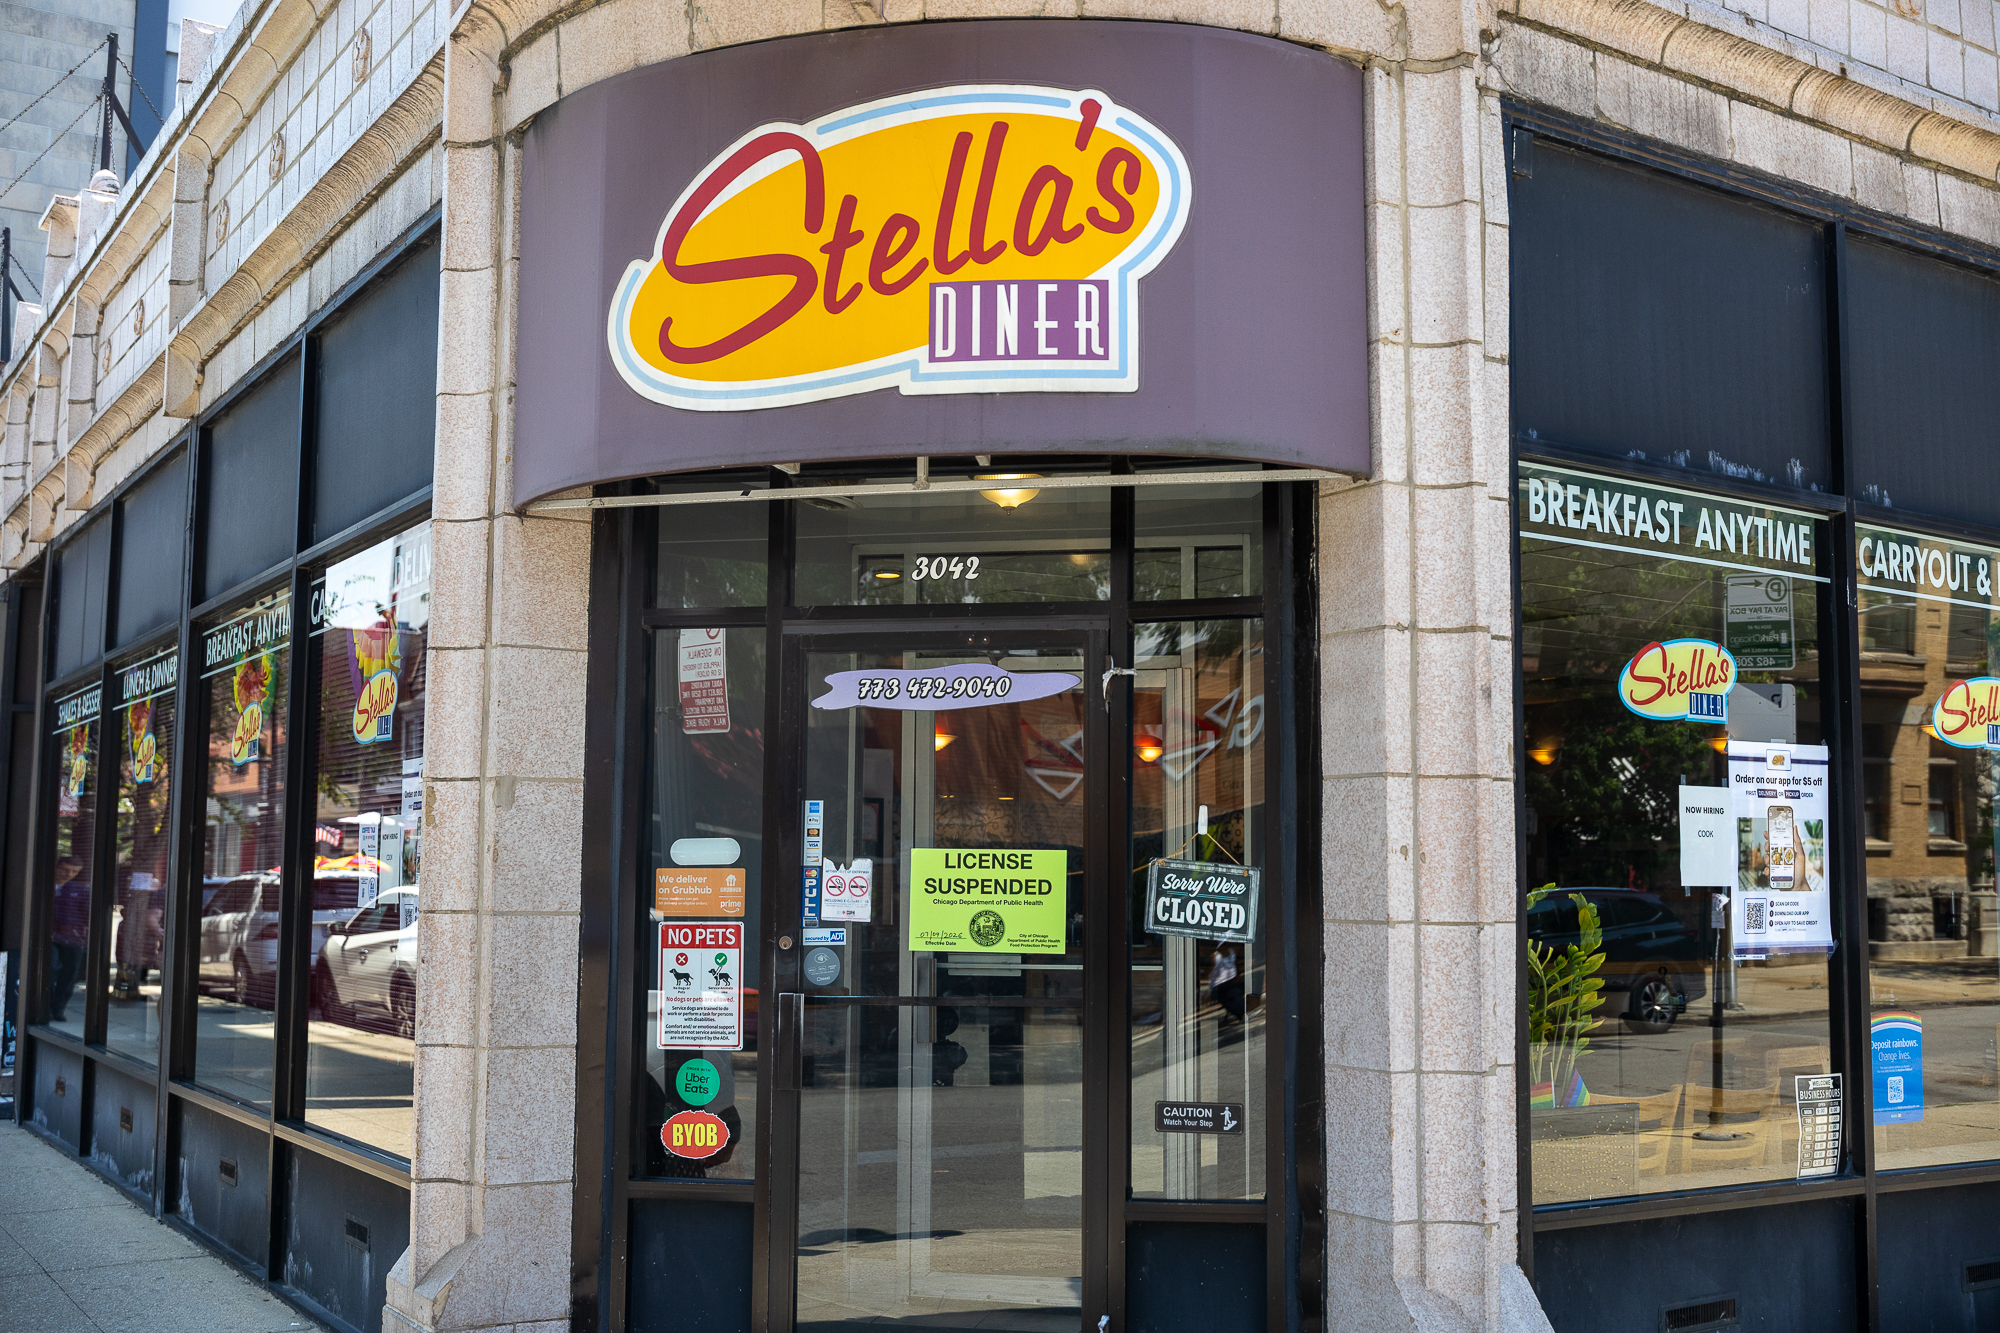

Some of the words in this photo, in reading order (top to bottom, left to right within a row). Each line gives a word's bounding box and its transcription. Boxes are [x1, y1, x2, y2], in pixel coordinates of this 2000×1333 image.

[658, 97, 1142, 364] Stella's
[934, 283, 1105, 358] DINER
[1528, 477, 1684, 545] BREAKFAST
[1694, 507, 1811, 565] ANYTIME
[911, 555, 980, 580] 3042
[1860, 536, 1971, 593] CARRYOUT
[1976, 557, 1992, 597] &
[206, 620, 254, 667] BREAKFAST
[123, 669, 145, 700] LUNCH
[145, 666, 151, 692] &
[151, 656, 177, 690] DINNER
[1629, 641, 1729, 705] Stella's
[859, 677, 900, 699] 773
[907, 675, 1012, 699] 472-9040
[355, 669, 396, 735] Stella's
[1691, 693, 1723, 716] DINER
[1941, 679, 2000, 735] Stell
[1735, 774, 1755, 783] Order
[1756, 776, 1765, 784] on
[1778, 777, 1791, 787] app
[1792, 776, 1802, 785] for
[1802, 777, 1812, 786] $5
[1813, 777, 1823, 786] off
[1685, 806, 1702, 814] NOW
[1703, 806, 1724, 815] HIRING
[1697, 830, 1714, 838] COOK
[944, 853, 1033, 870] LICENSE
[659, 875, 674, 883] We
[676, 875, 708, 883] deliver
[924, 877, 1053, 895] SUSPENDED
[1161, 873, 1204, 897] Sorry
[672, 886, 713, 894] Grubhub
[804, 878, 817, 916] PULL
[720, 899, 742, 909] prime
[932, 898, 958, 906] Chicago
[1156, 896, 1246, 929] CLOSED
[668, 928, 692, 945] NO
[695, 928, 736, 945] PETS
[830, 933, 845, 941] ADT
[1871, 1039, 1891, 1051] Deposit
[1892, 1038, 1919, 1048] rainbows.
[1878, 1051, 1897, 1062] Change
[1898, 1050, 1911, 1060] lives.
[685, 1072, 710, 1083] Uber
[684, 1083, 709, 1094] Eats
[1800, 1090, 1826, 1100] BUSINESS
[1826, 1089, 1840, 1098] HOURS
[1163, 1107, 1212, 1118] CAUTION
[1163, 1118, 1182, 1126] Watch
[1199, 1120, 1214, 1128] Step
[672, 1122, 718, 1147] BYOB
